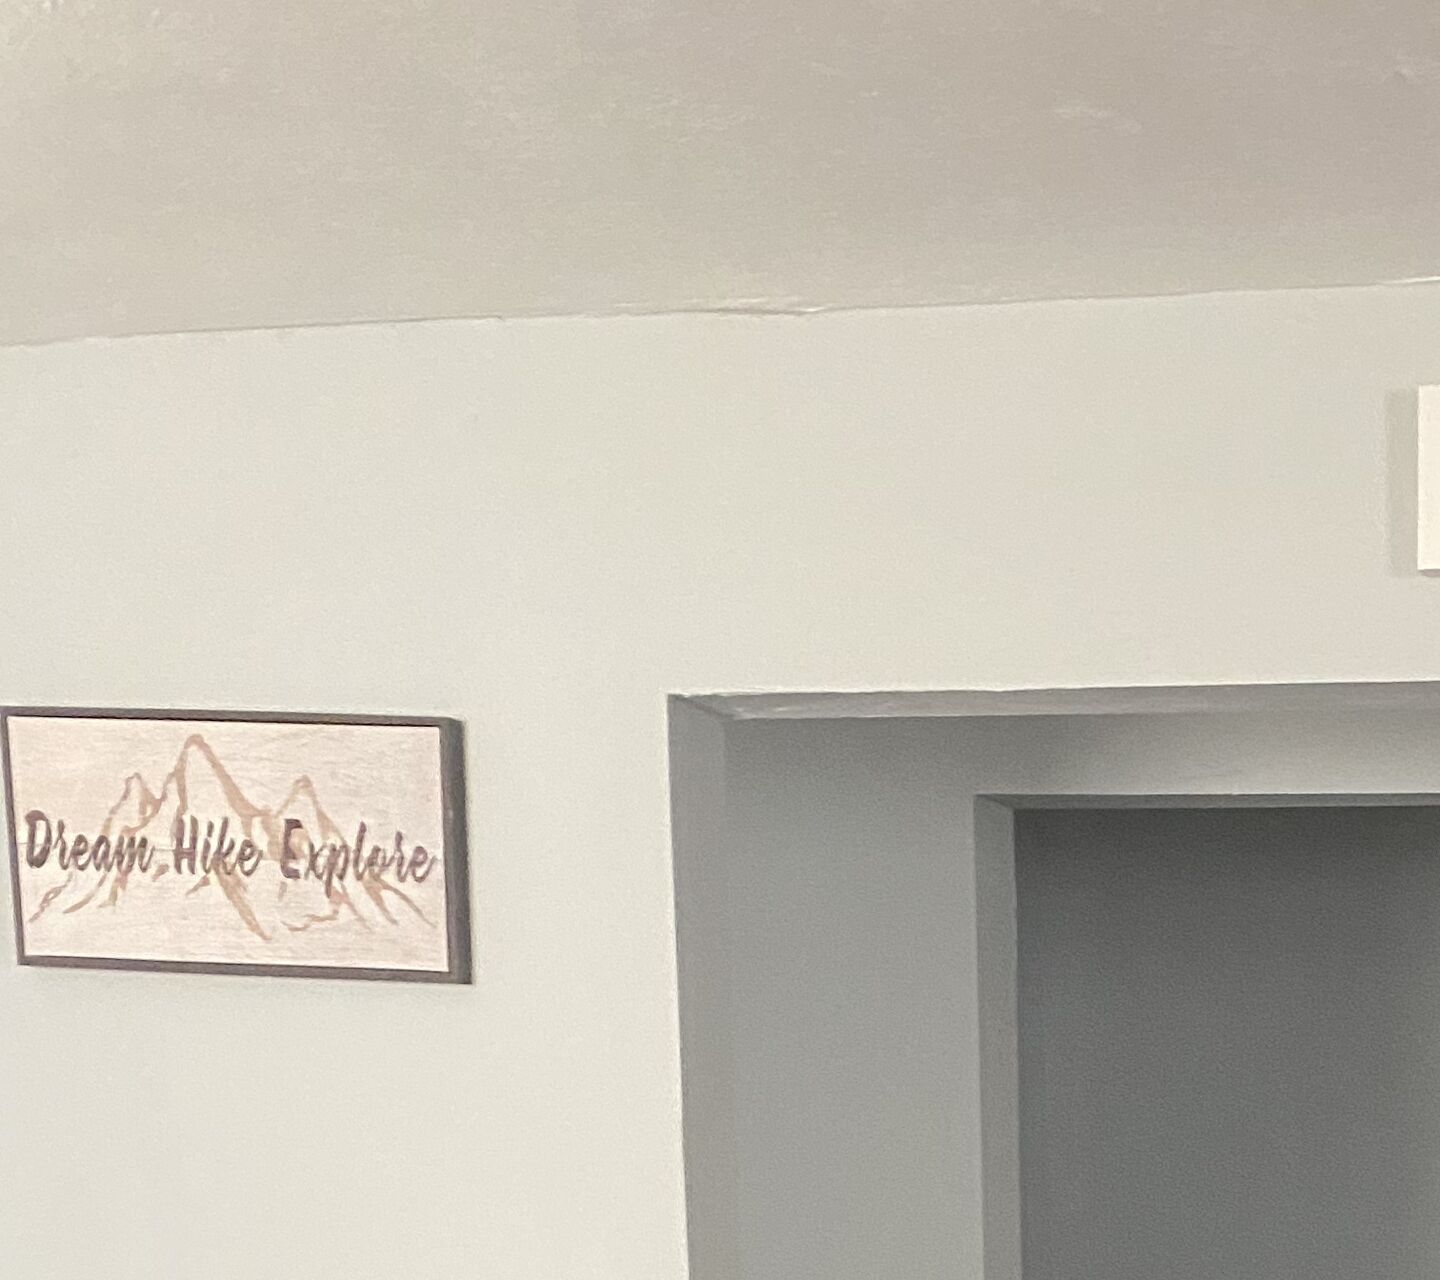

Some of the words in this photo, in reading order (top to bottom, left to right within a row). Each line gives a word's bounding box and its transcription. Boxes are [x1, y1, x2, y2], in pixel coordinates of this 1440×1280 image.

[24, 810, 155, 873] Dream
[173, 815, 262, 876] Hike
[281, 819, 439, 898] Explore
